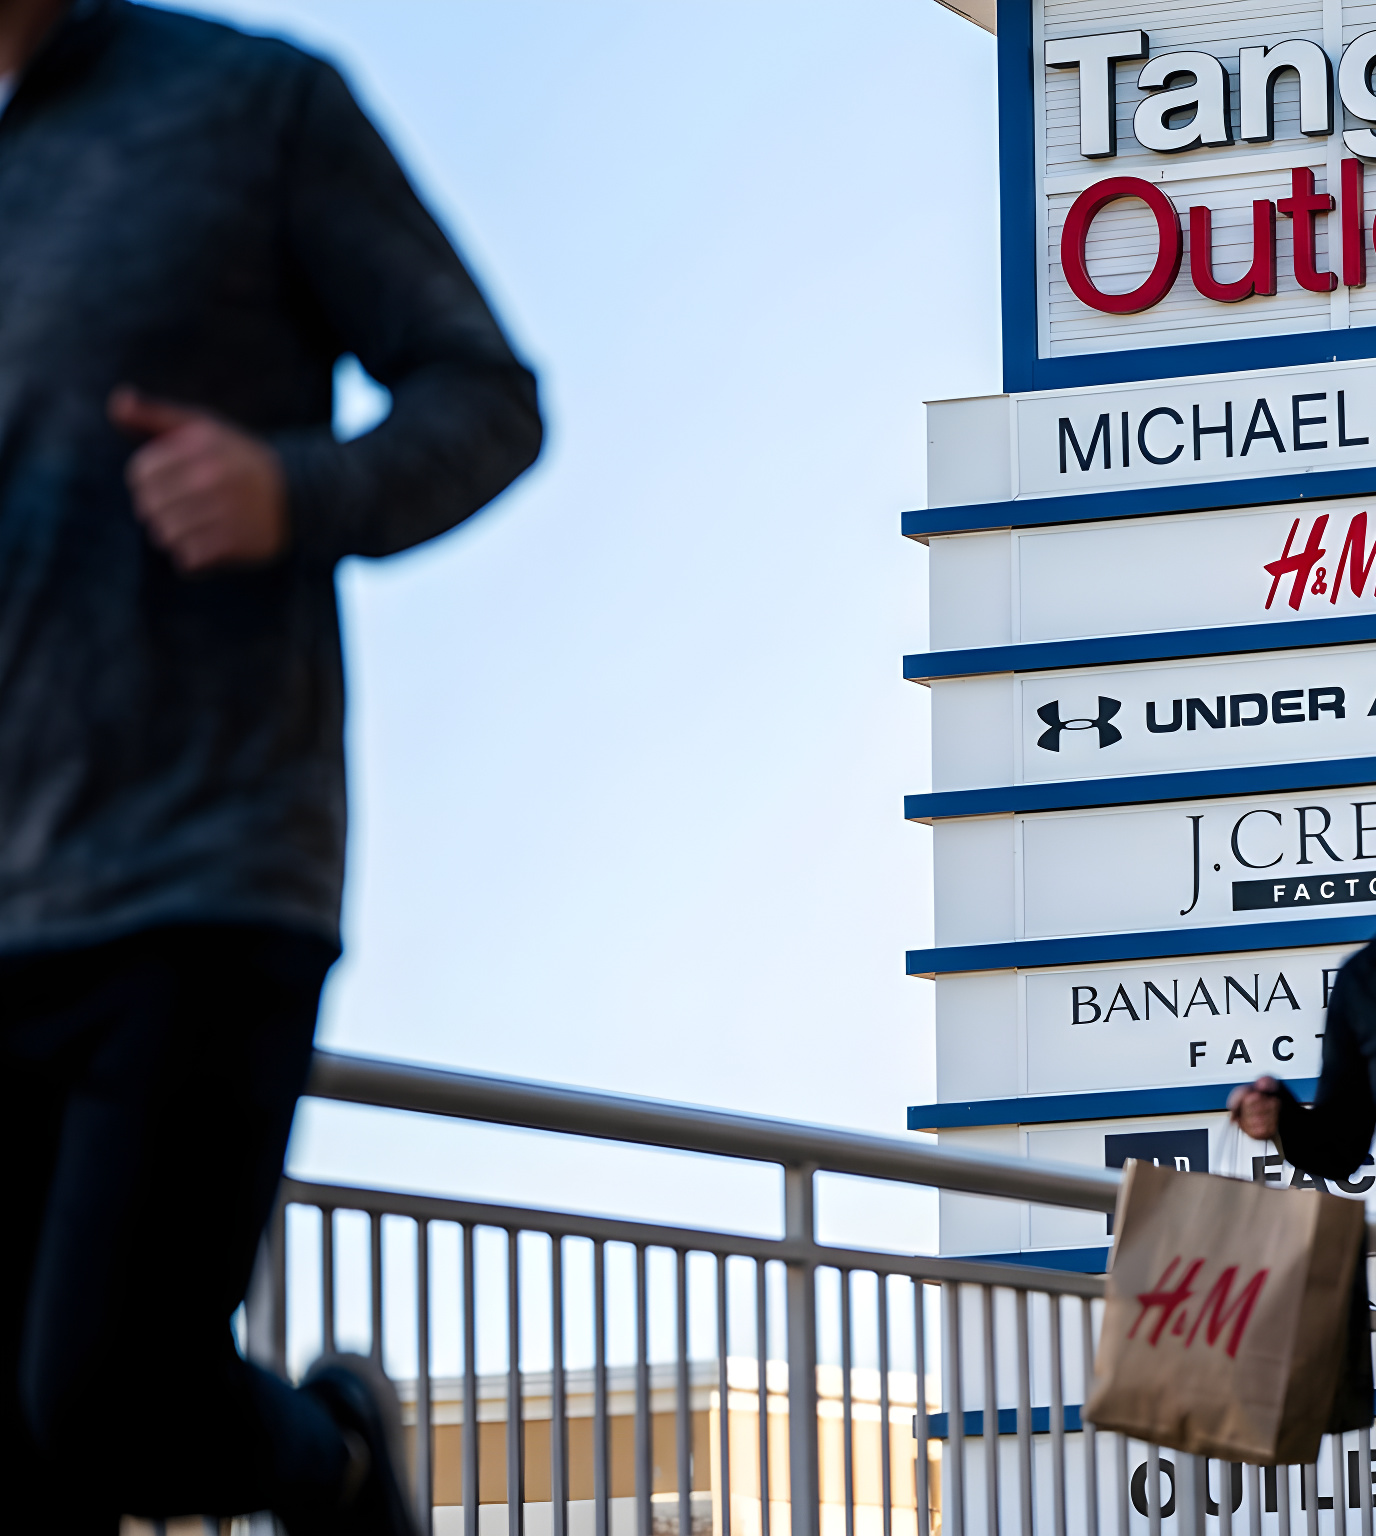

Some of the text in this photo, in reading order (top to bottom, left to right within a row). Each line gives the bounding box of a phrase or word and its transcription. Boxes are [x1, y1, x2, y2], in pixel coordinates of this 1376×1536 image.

[1058, 390, 1369, 474] MICHAEL
[1146, 686, 1346, 733] UNDER
[1071, 971, 1301, 1026] BANANA
[1189, 1034, 1325, 1068] FAC
[1127, 1255, 1270, 1359] H&M
